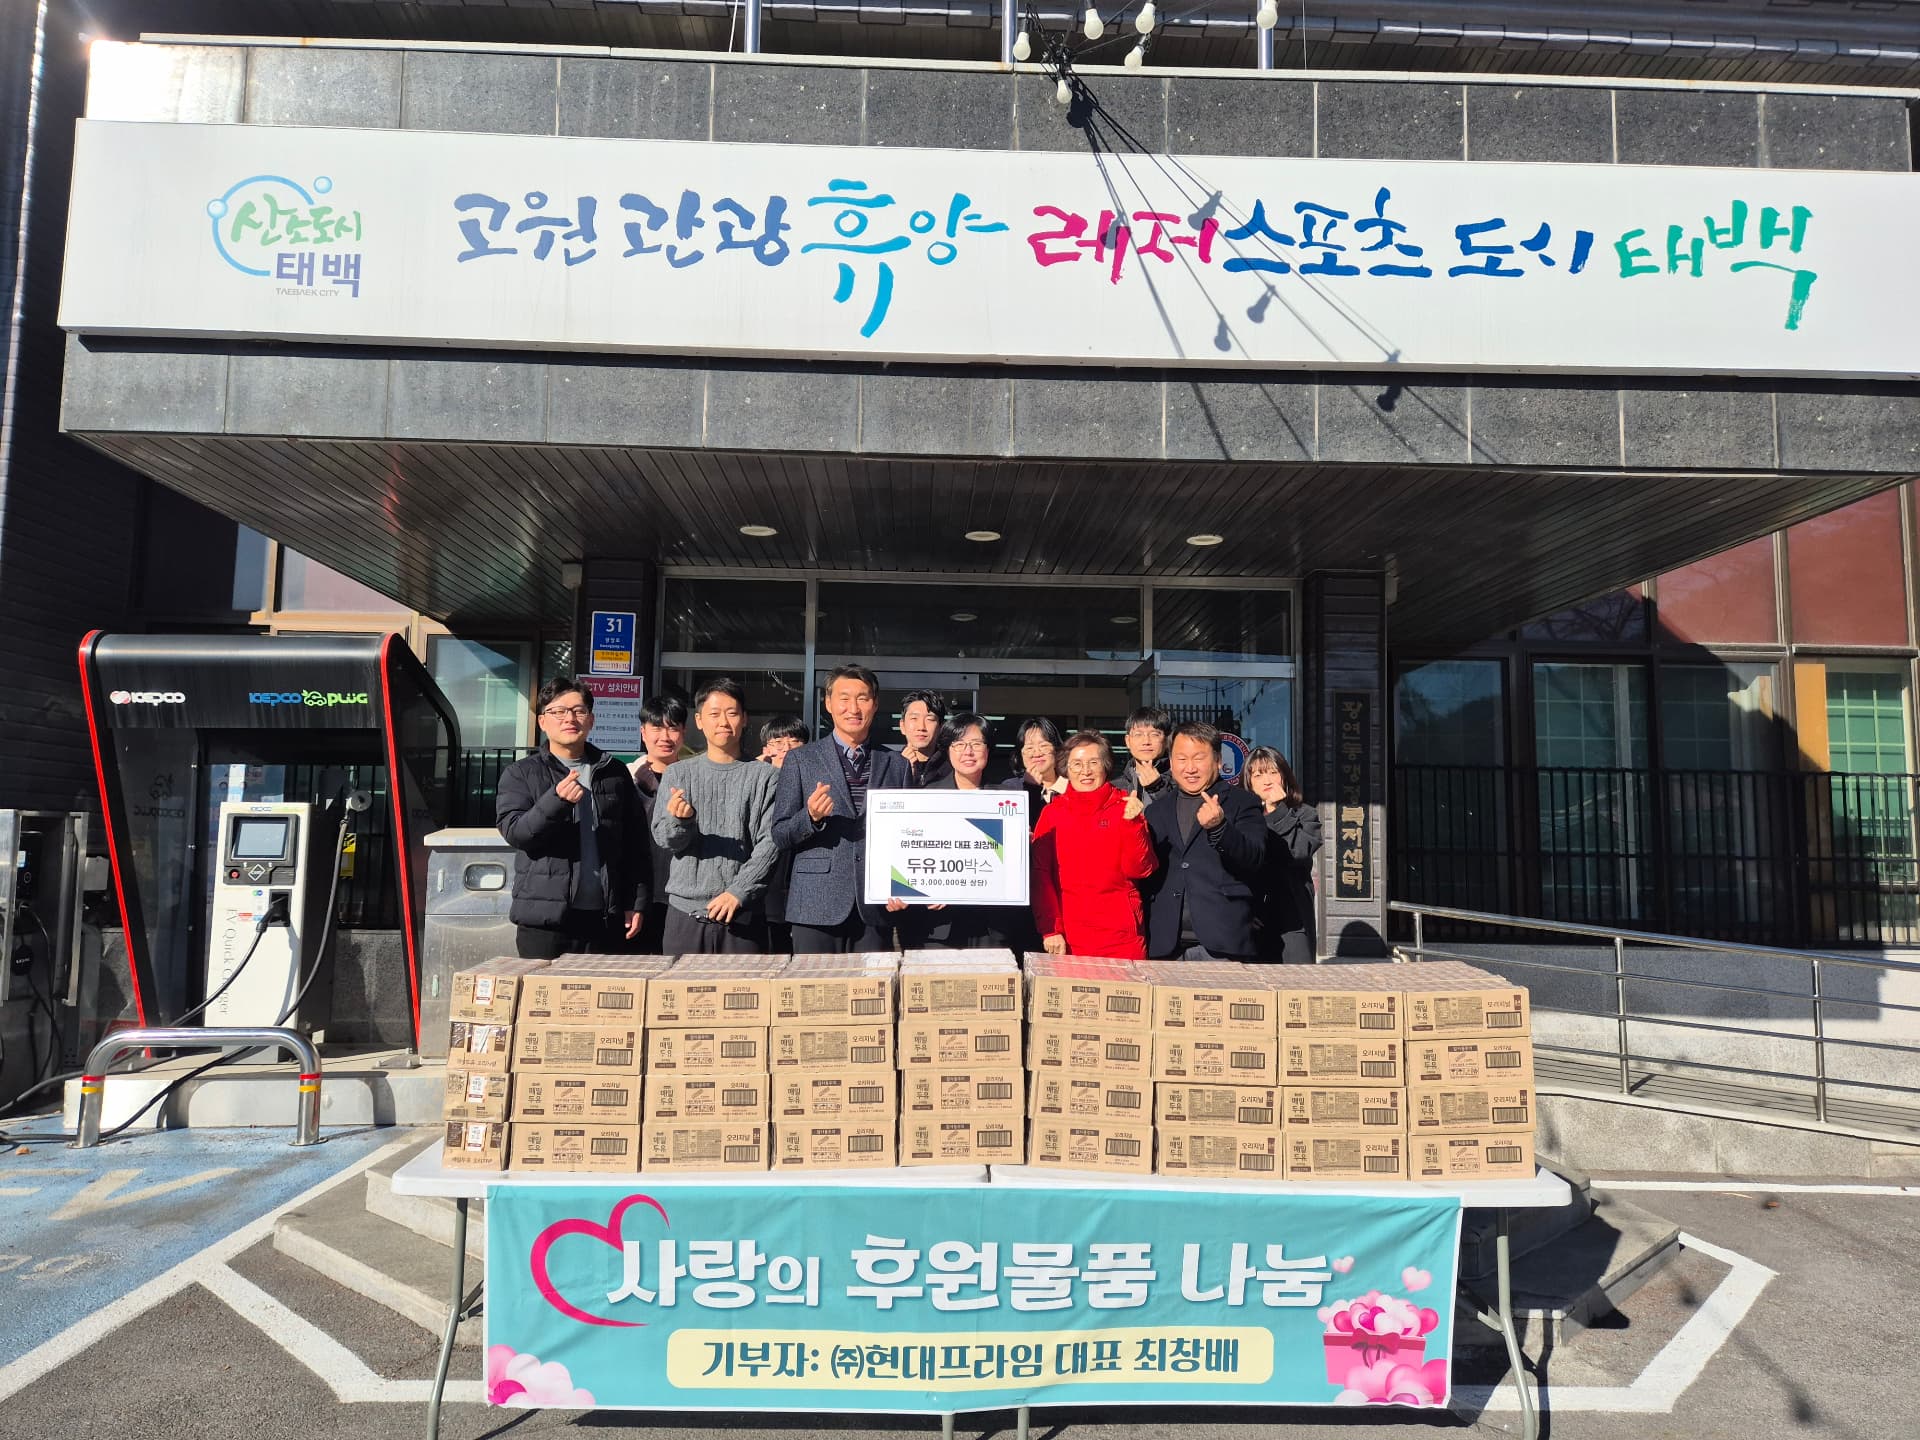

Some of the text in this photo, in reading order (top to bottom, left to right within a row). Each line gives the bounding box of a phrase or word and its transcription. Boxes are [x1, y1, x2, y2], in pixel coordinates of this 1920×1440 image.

[231, 192, 362, 246] 산소도시
[454, 178, 1817, 338] 고원 관광 휴양 레저 스포츠 도시 태백
[276, 252, 361, 298] 태백
[276, 287, 340, 297] TAEBAEK CITY
[606, 618, 622, 633] 31
[607, 683, 638, 693] 설치안내
[131, 691, 186, 706] KEPCO
[249, 691, 301, 706] KEPCO
[954, 840, 972, 849] 대표
[973, 840, 999, 850] 최창배
[907, 858, 994, 875] 두유 100박스
[920, 878, 967, 887] 3,000,000원
[969, 878, 988, 887] 상당)
[222, 928, 237, 965] Quick
[852, 988, 876, 996] 오리지널
[982, 983, 1005, 991] 오리지널
[1361, 1001, 1385, 1009] 오리지널
[1487, 1000, 1511, 1008] 오리지널
[600, 1037, 624, 1045] 오리지널
[852, 1035, 876, 1043] 오리지널
[1362, 1049, 1386, 1057] 오리지널
[1241, 1095, 1264, 1104] 오리지널
[726, 1134, 751, 1142] 오리지널
[1241, 1142, 1265, 1151] 오리지널
[1365, 1144, 1389, 1152] 오리지널
[607, 1233, 1333, 1312] 사랑의 후원물품 나눔
[702, 1341, 820, 1378] 기부자:
[1055, 1339, 1122, 1376] 대표
[1133, 1337, 1239, 1374] 최창배
